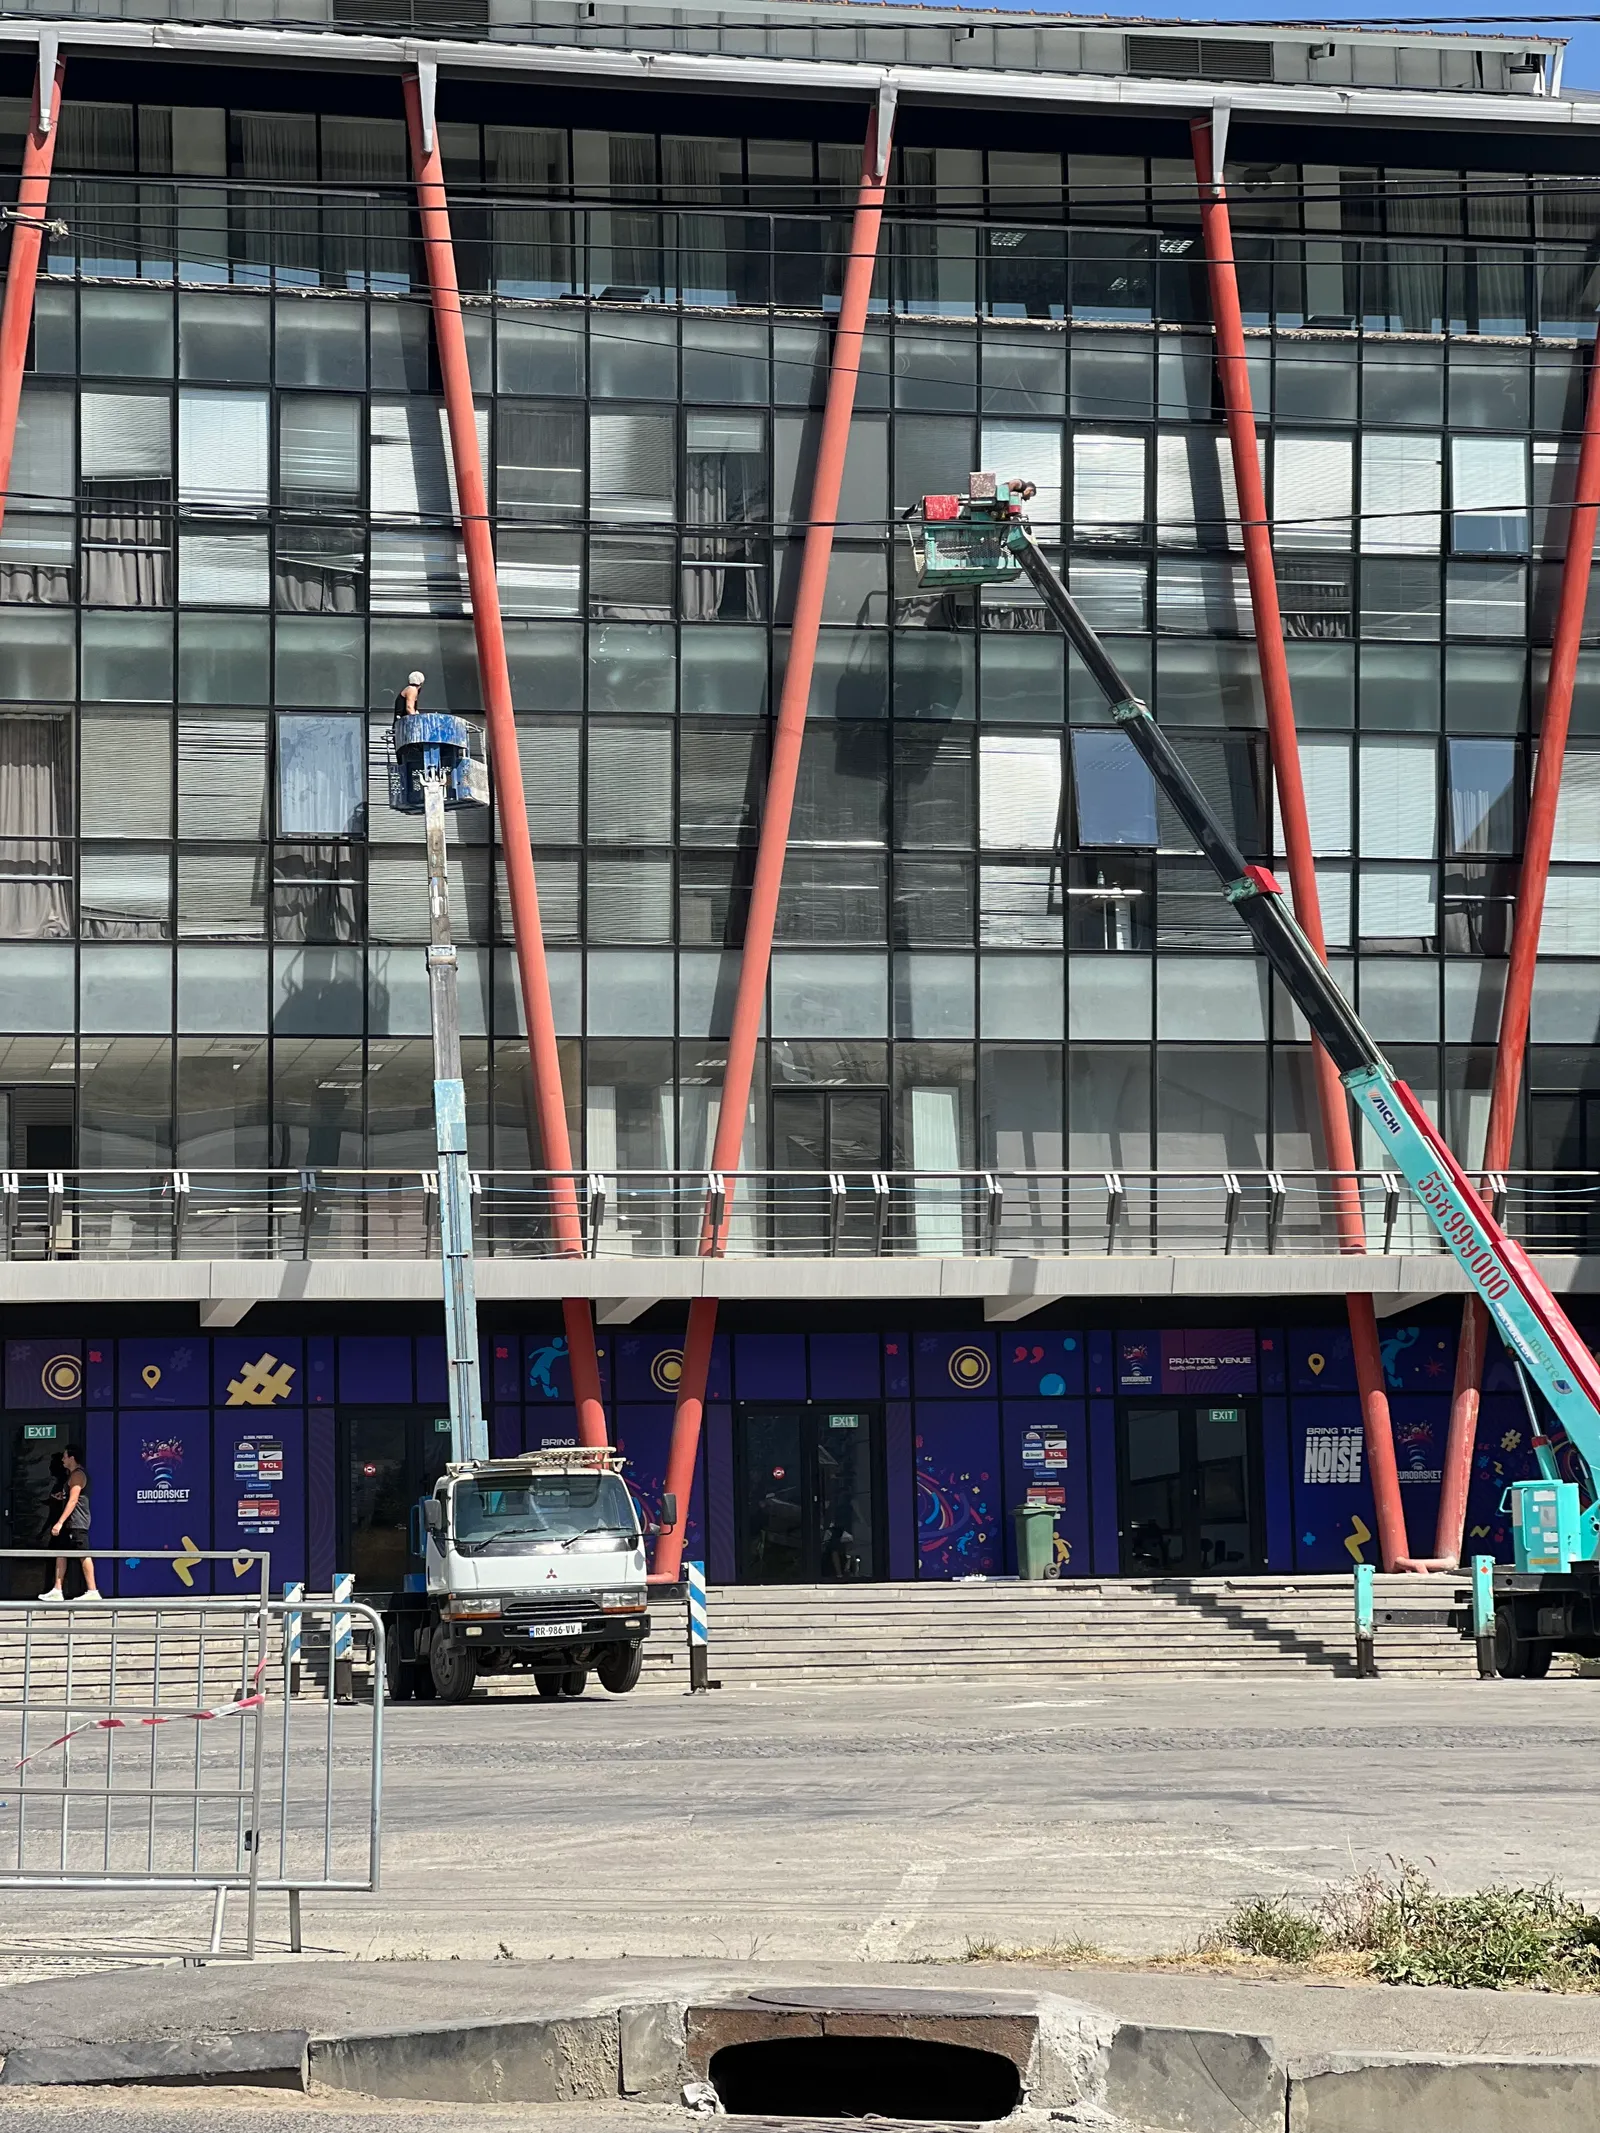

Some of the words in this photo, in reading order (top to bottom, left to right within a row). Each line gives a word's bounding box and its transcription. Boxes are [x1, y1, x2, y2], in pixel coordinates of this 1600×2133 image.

[1371, 1097, 1401, 1134] AICHI
[1168, 1357, 1216, 1365] PRACTICE
[1218, 1356, 1251, 1364] VENUE
[1212, 1410, 1234, 1420] EXIT
[438, 1421, 451, 1430] EX
[832, 1416, 855, 1427] EXIT
[28, 1426, 53, 1437] EXIT
[1306, 1427, 1339, 1435] BRING
[1341, 1426, 1364, 1435] THE
[541, 1438, 576, 1446] BRING
[136, 1489, 190, 1499] EUROBASKET
